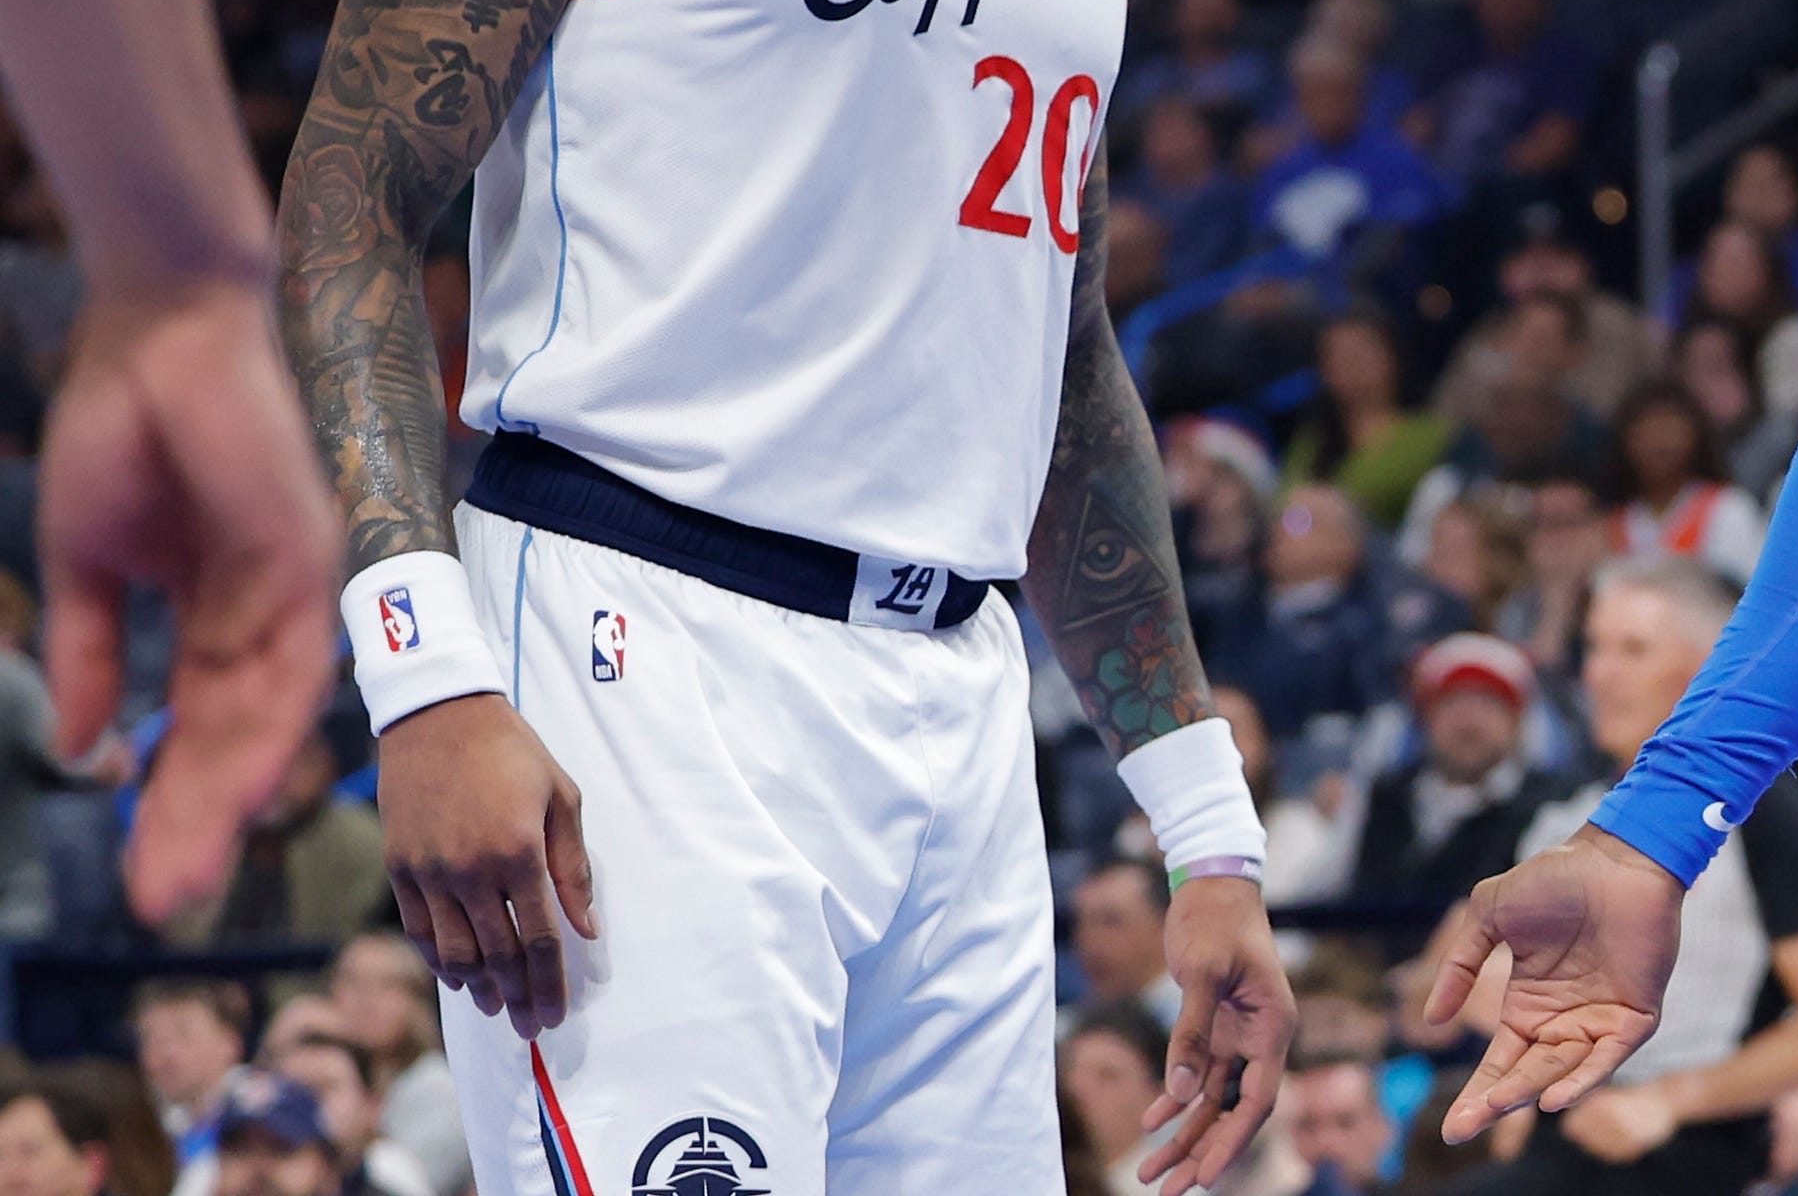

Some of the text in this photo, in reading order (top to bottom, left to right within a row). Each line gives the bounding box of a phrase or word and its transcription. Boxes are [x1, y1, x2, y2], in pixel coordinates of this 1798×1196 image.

[958, 55, 1099, 255] 20
[387, 588, 408, 604] NBA
[595, 664, 613, 679] NBA
